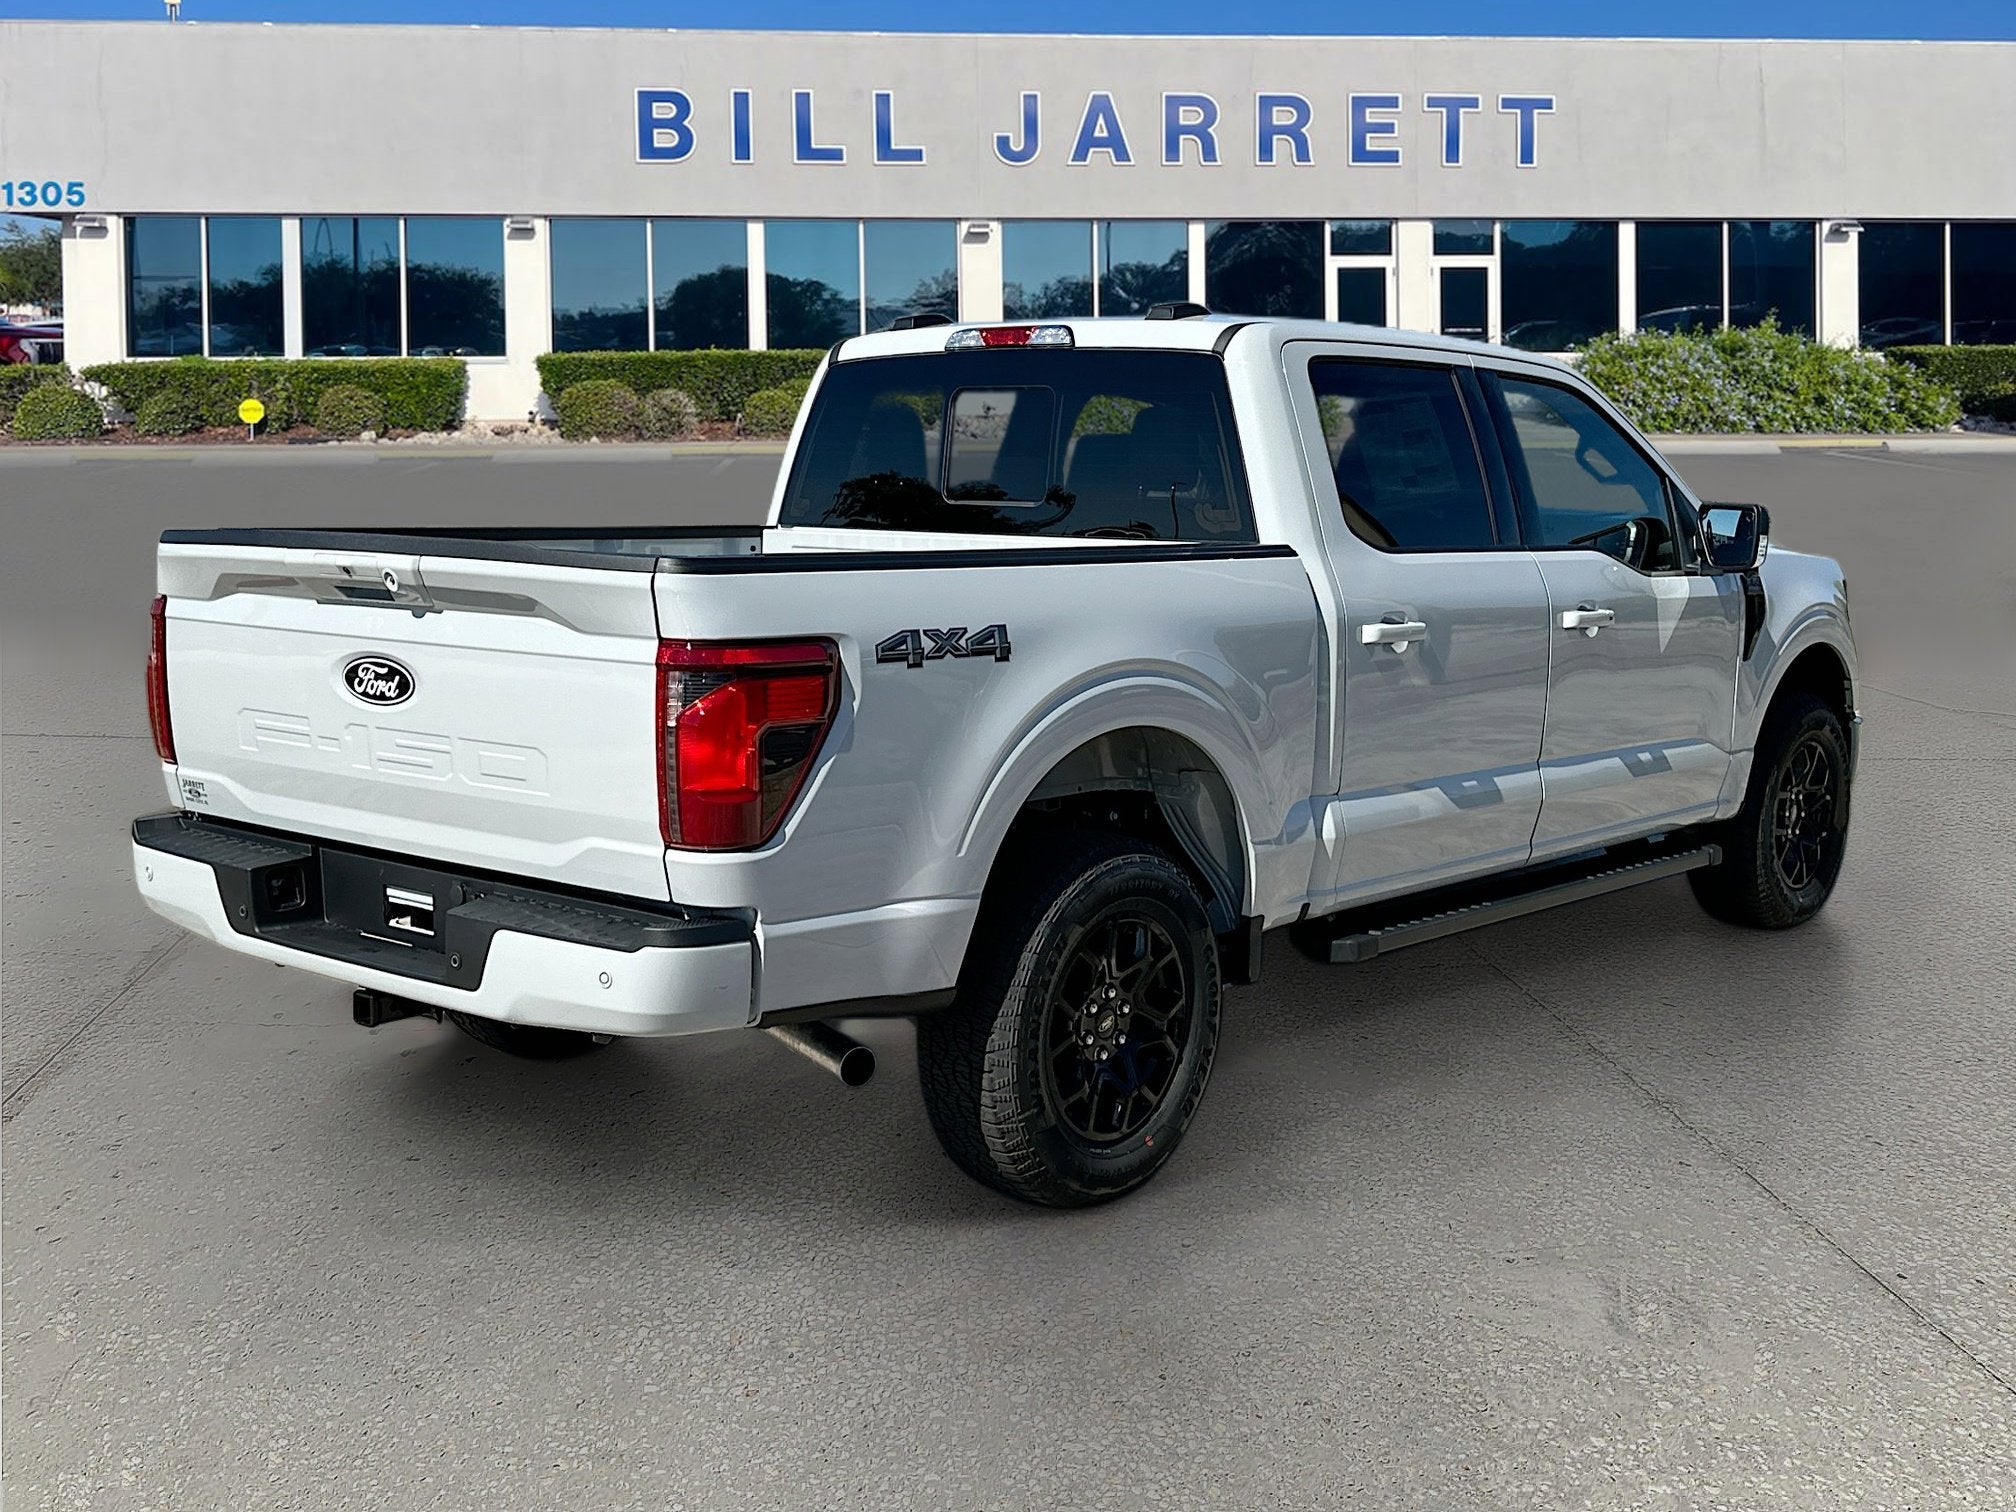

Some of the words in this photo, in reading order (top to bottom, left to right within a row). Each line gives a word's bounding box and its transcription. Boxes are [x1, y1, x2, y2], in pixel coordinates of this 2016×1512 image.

[634, 87, 926, 165] BILL
[993, 91, 1556, 167] JARRETT
[1, 181, 85, 207] 1305
[354, 663, 400, 698] Ford
[238, 707, 550, 797] F-150
